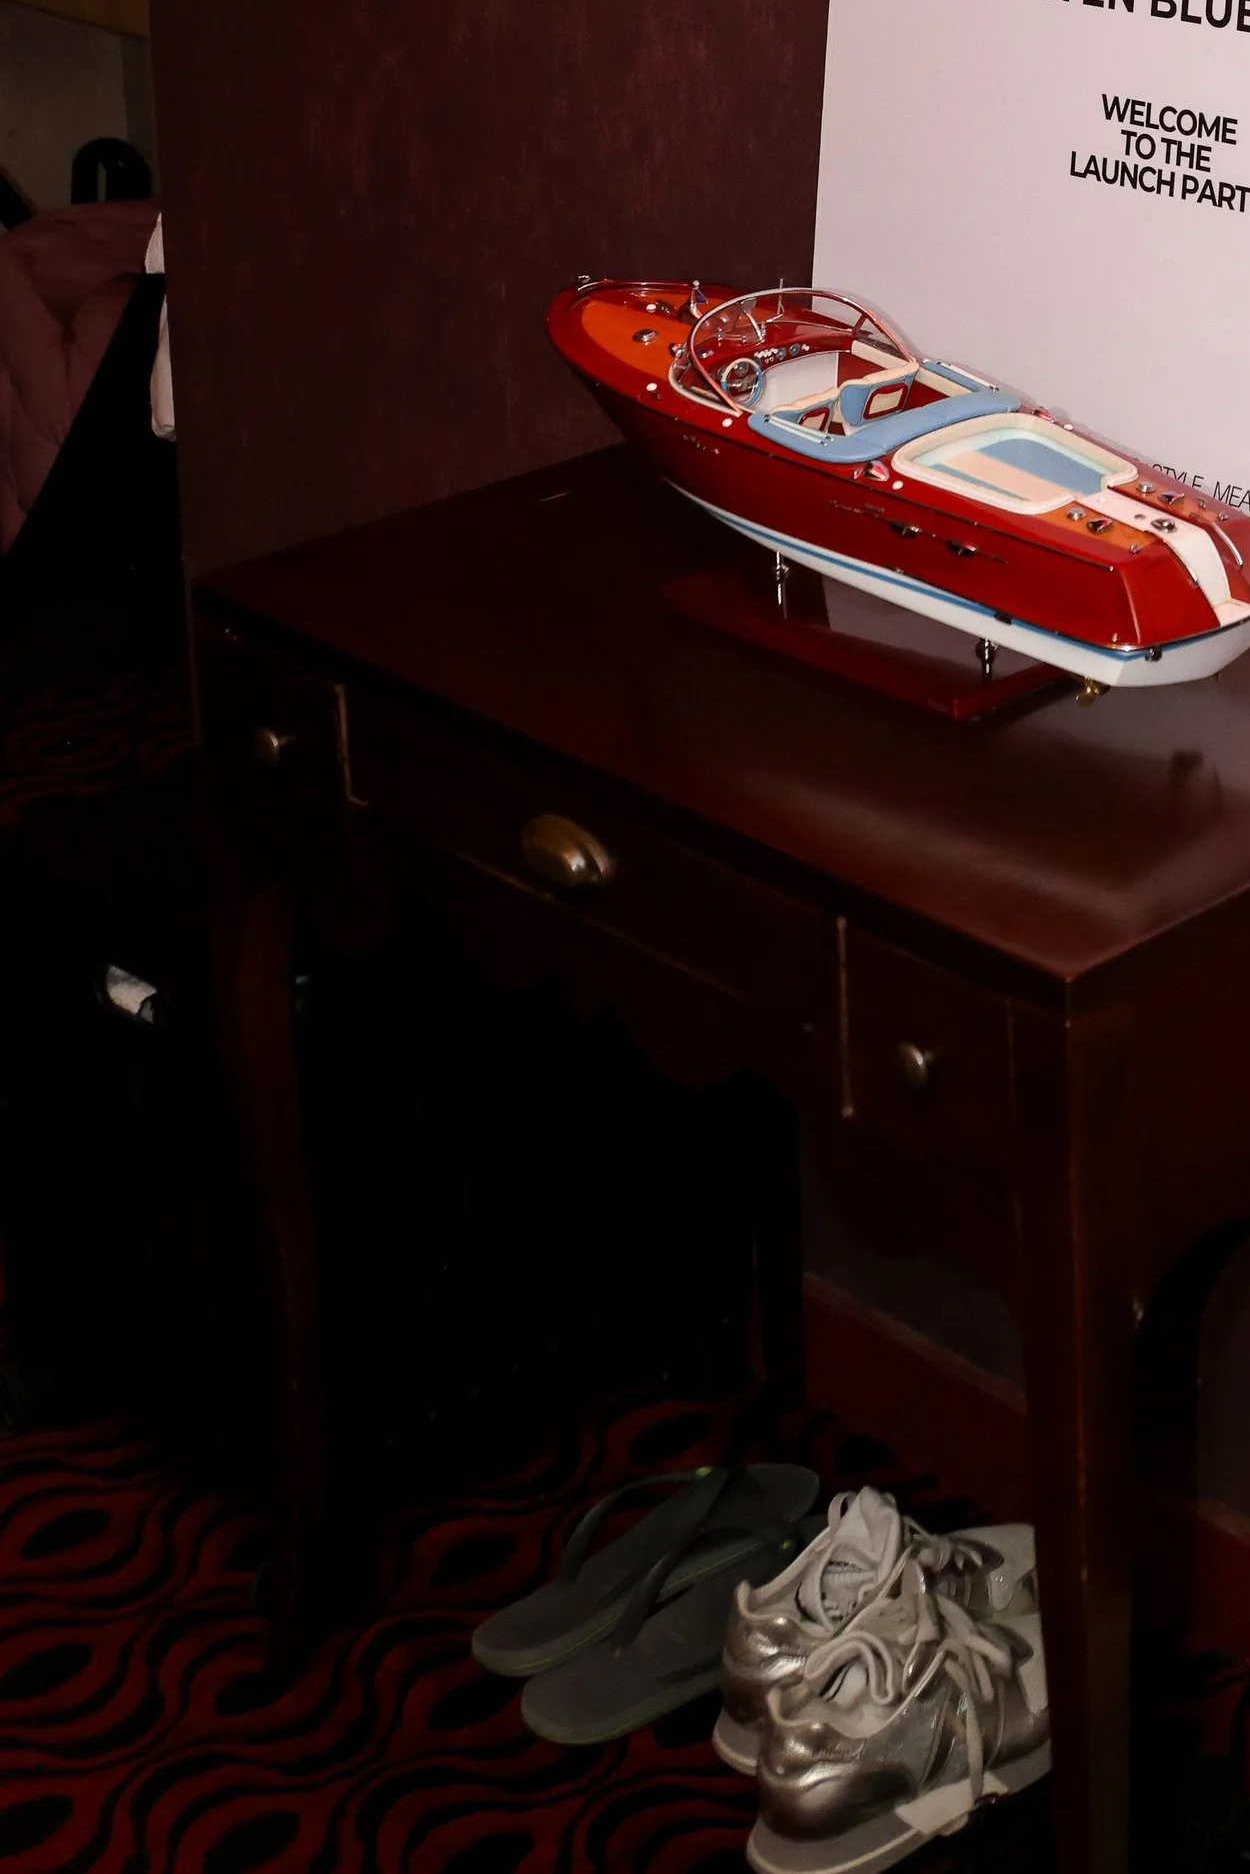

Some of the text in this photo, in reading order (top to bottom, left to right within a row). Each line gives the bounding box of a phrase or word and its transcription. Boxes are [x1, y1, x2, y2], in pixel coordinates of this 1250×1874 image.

[1101, 93, 1238, 146] WELCOME
[1069, 150, 1176, 198] LAUNCH
[1120, 129, 1212, 173] TO THE
